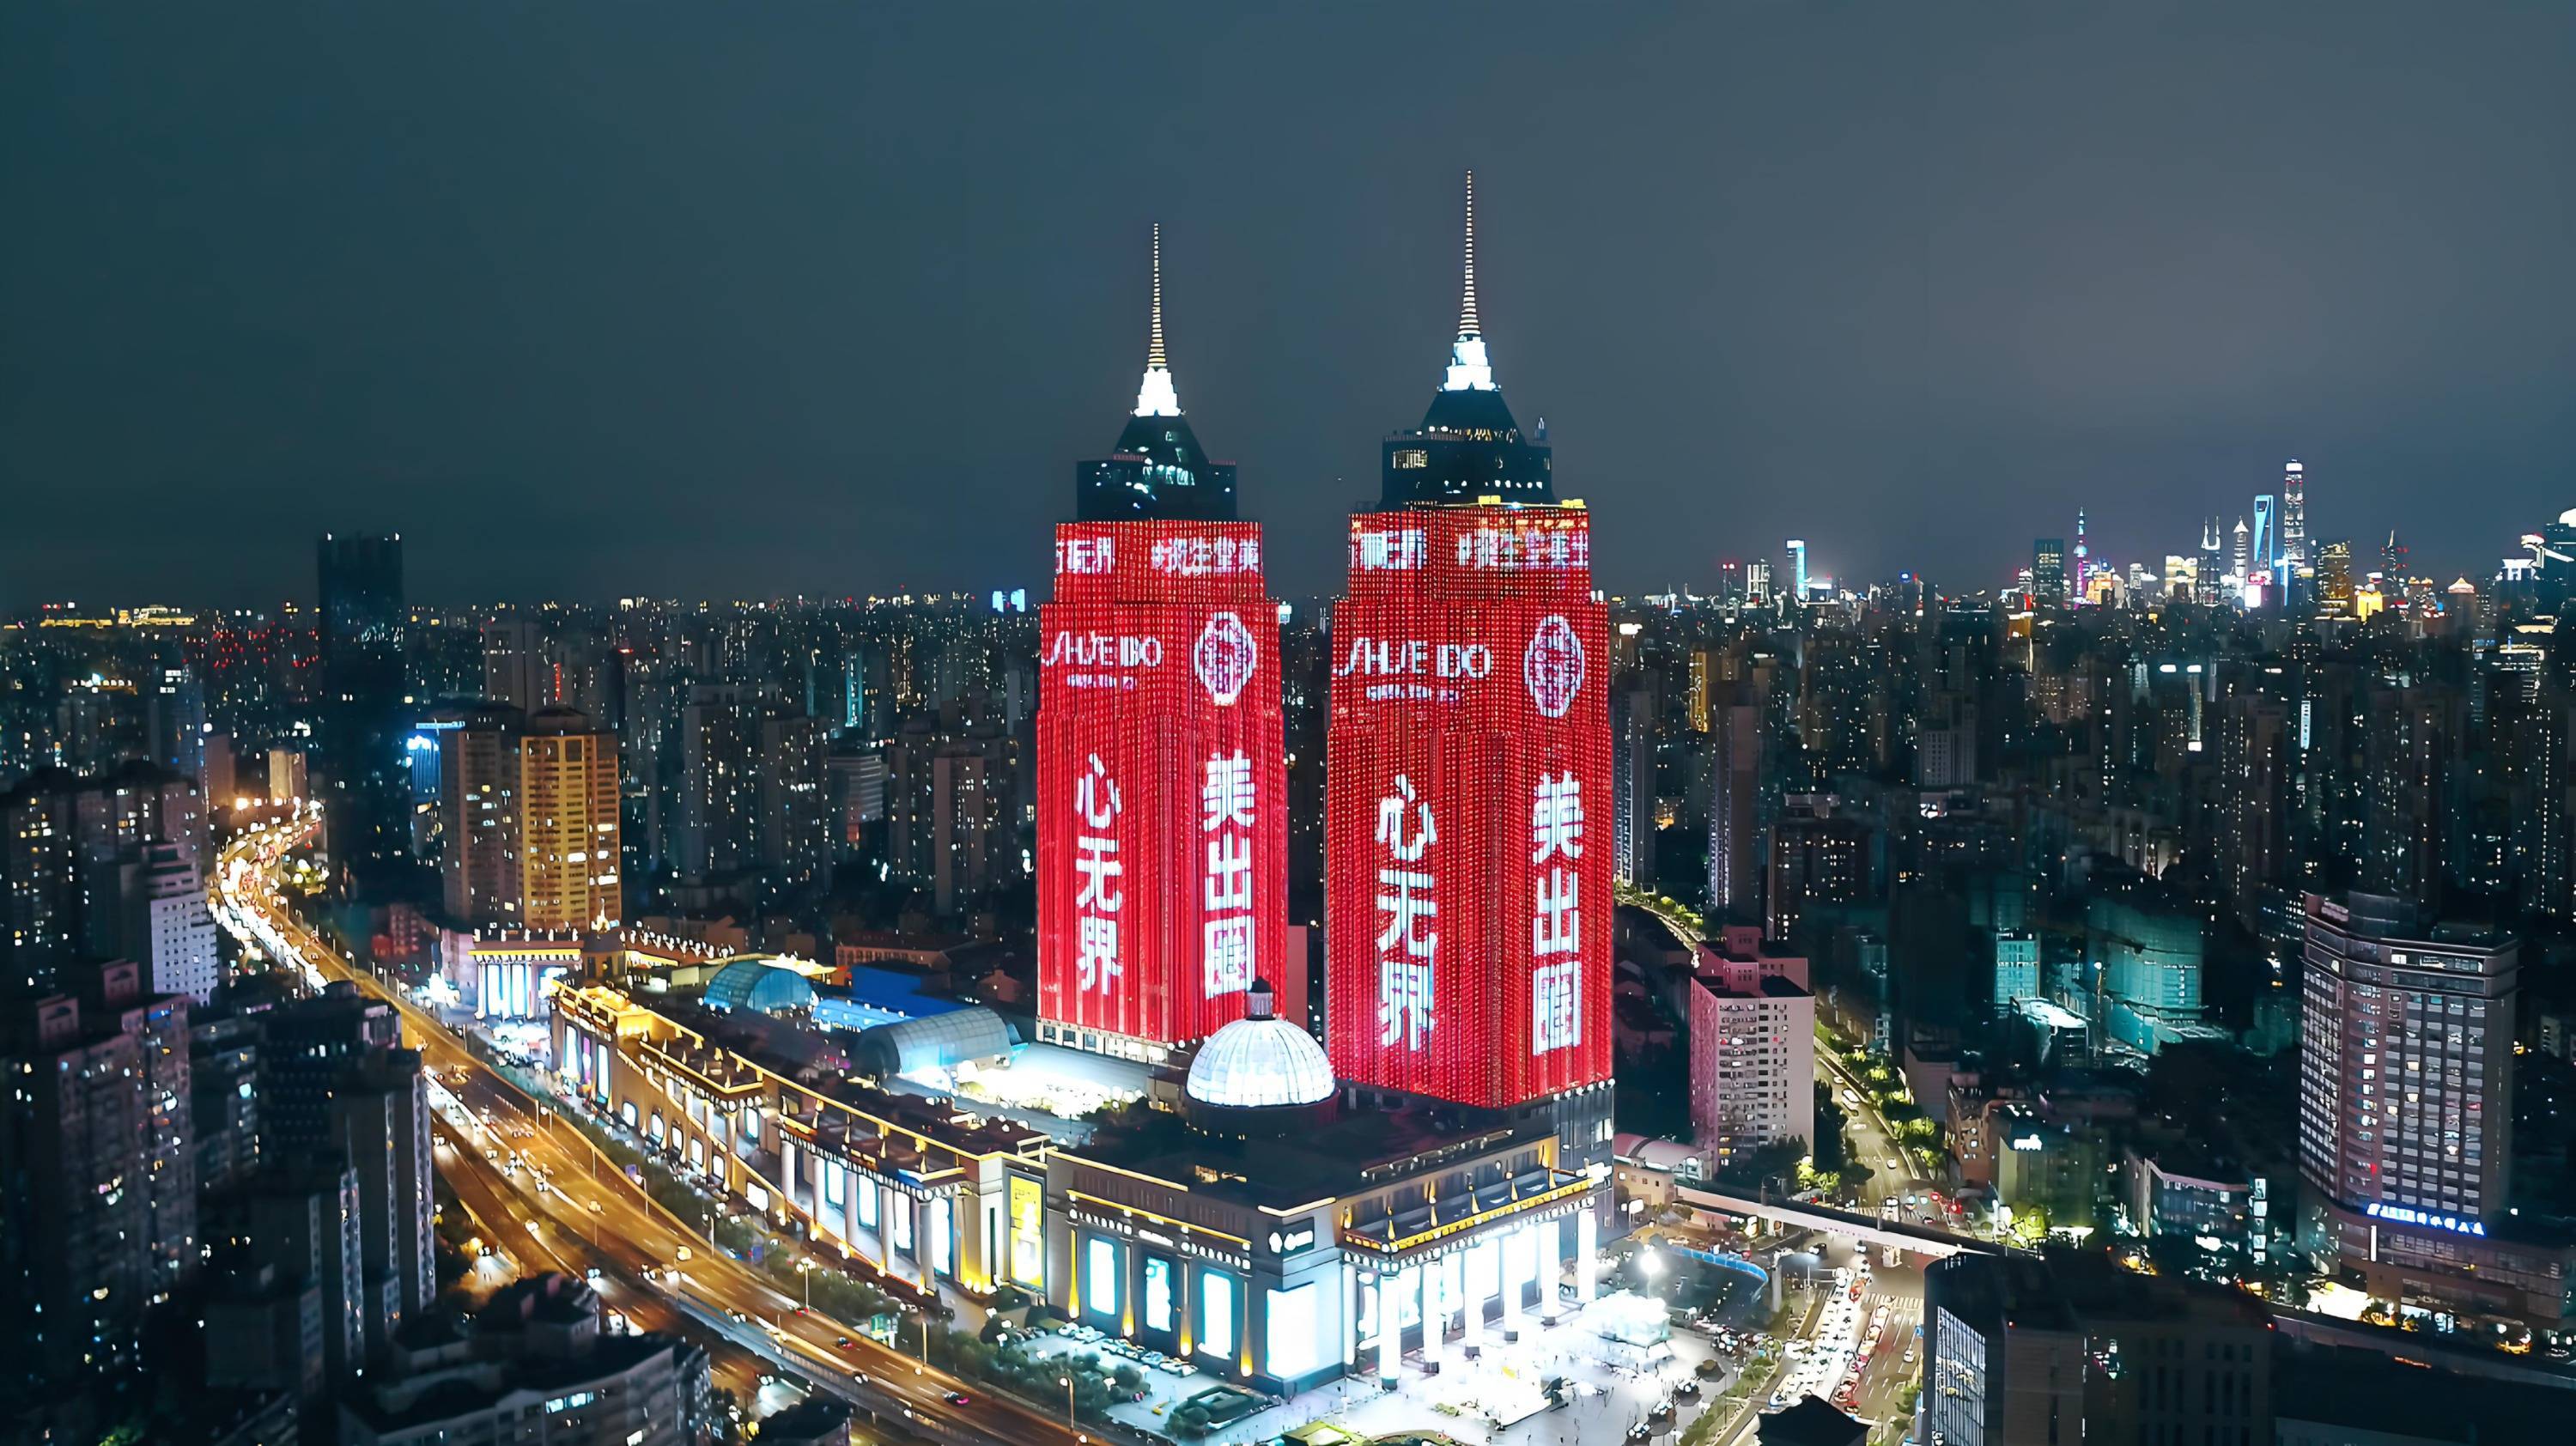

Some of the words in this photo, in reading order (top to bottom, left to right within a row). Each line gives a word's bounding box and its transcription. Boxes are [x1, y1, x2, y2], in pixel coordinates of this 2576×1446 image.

[1075, 752, 1122, 995] 心无界
[1375, 774, 1437, 1053] 心无界
